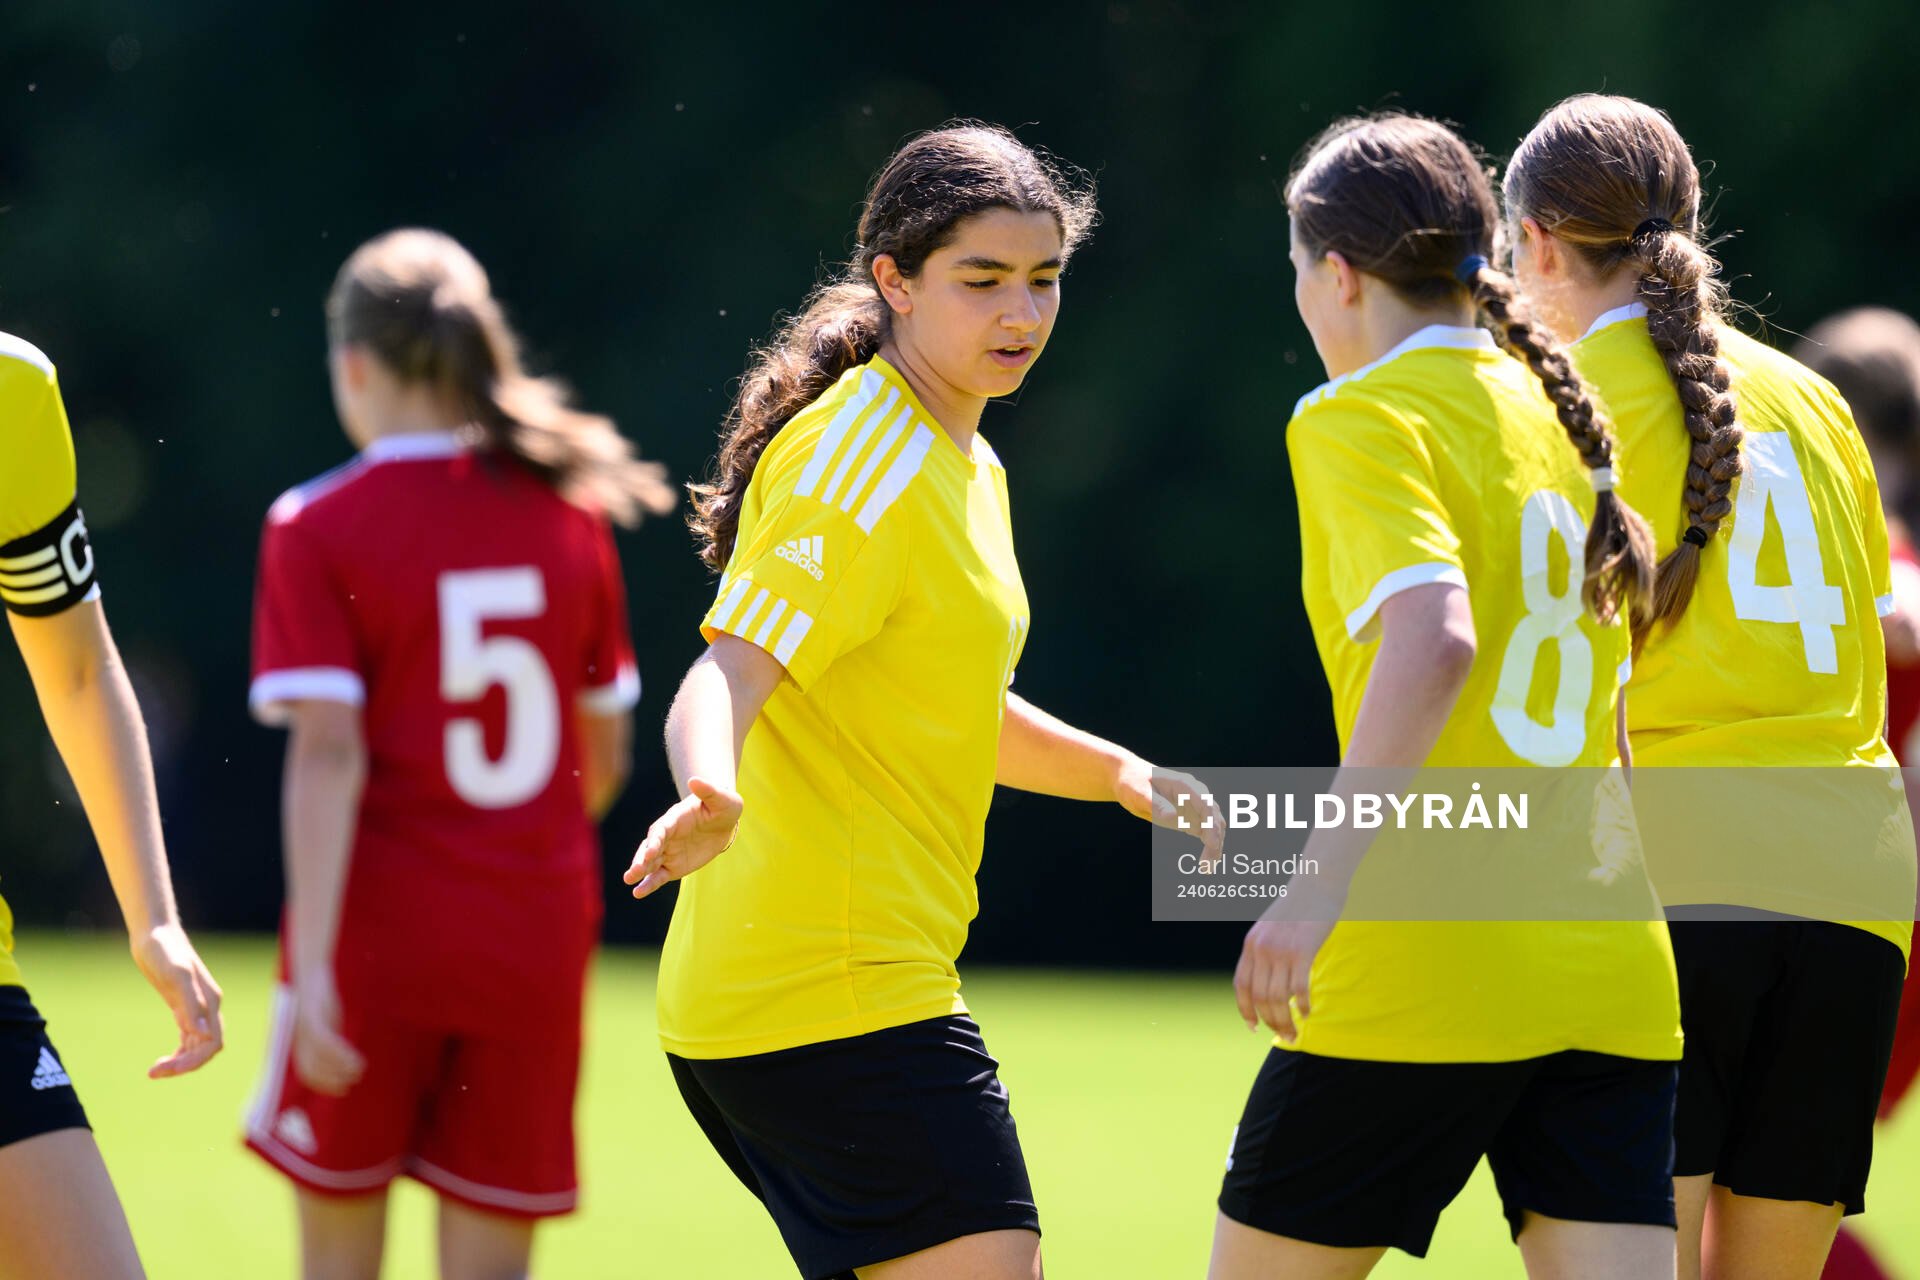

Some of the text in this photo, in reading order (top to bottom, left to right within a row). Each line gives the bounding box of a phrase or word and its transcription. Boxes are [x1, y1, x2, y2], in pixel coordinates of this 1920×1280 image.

[60, 517, 94, 586] C
[775, 545, 824, 581] adidas
[1490, 489, 1593, 767] 8
[1728, 431, 1846, 674] 4
[437, 564, 562, 810] 5
